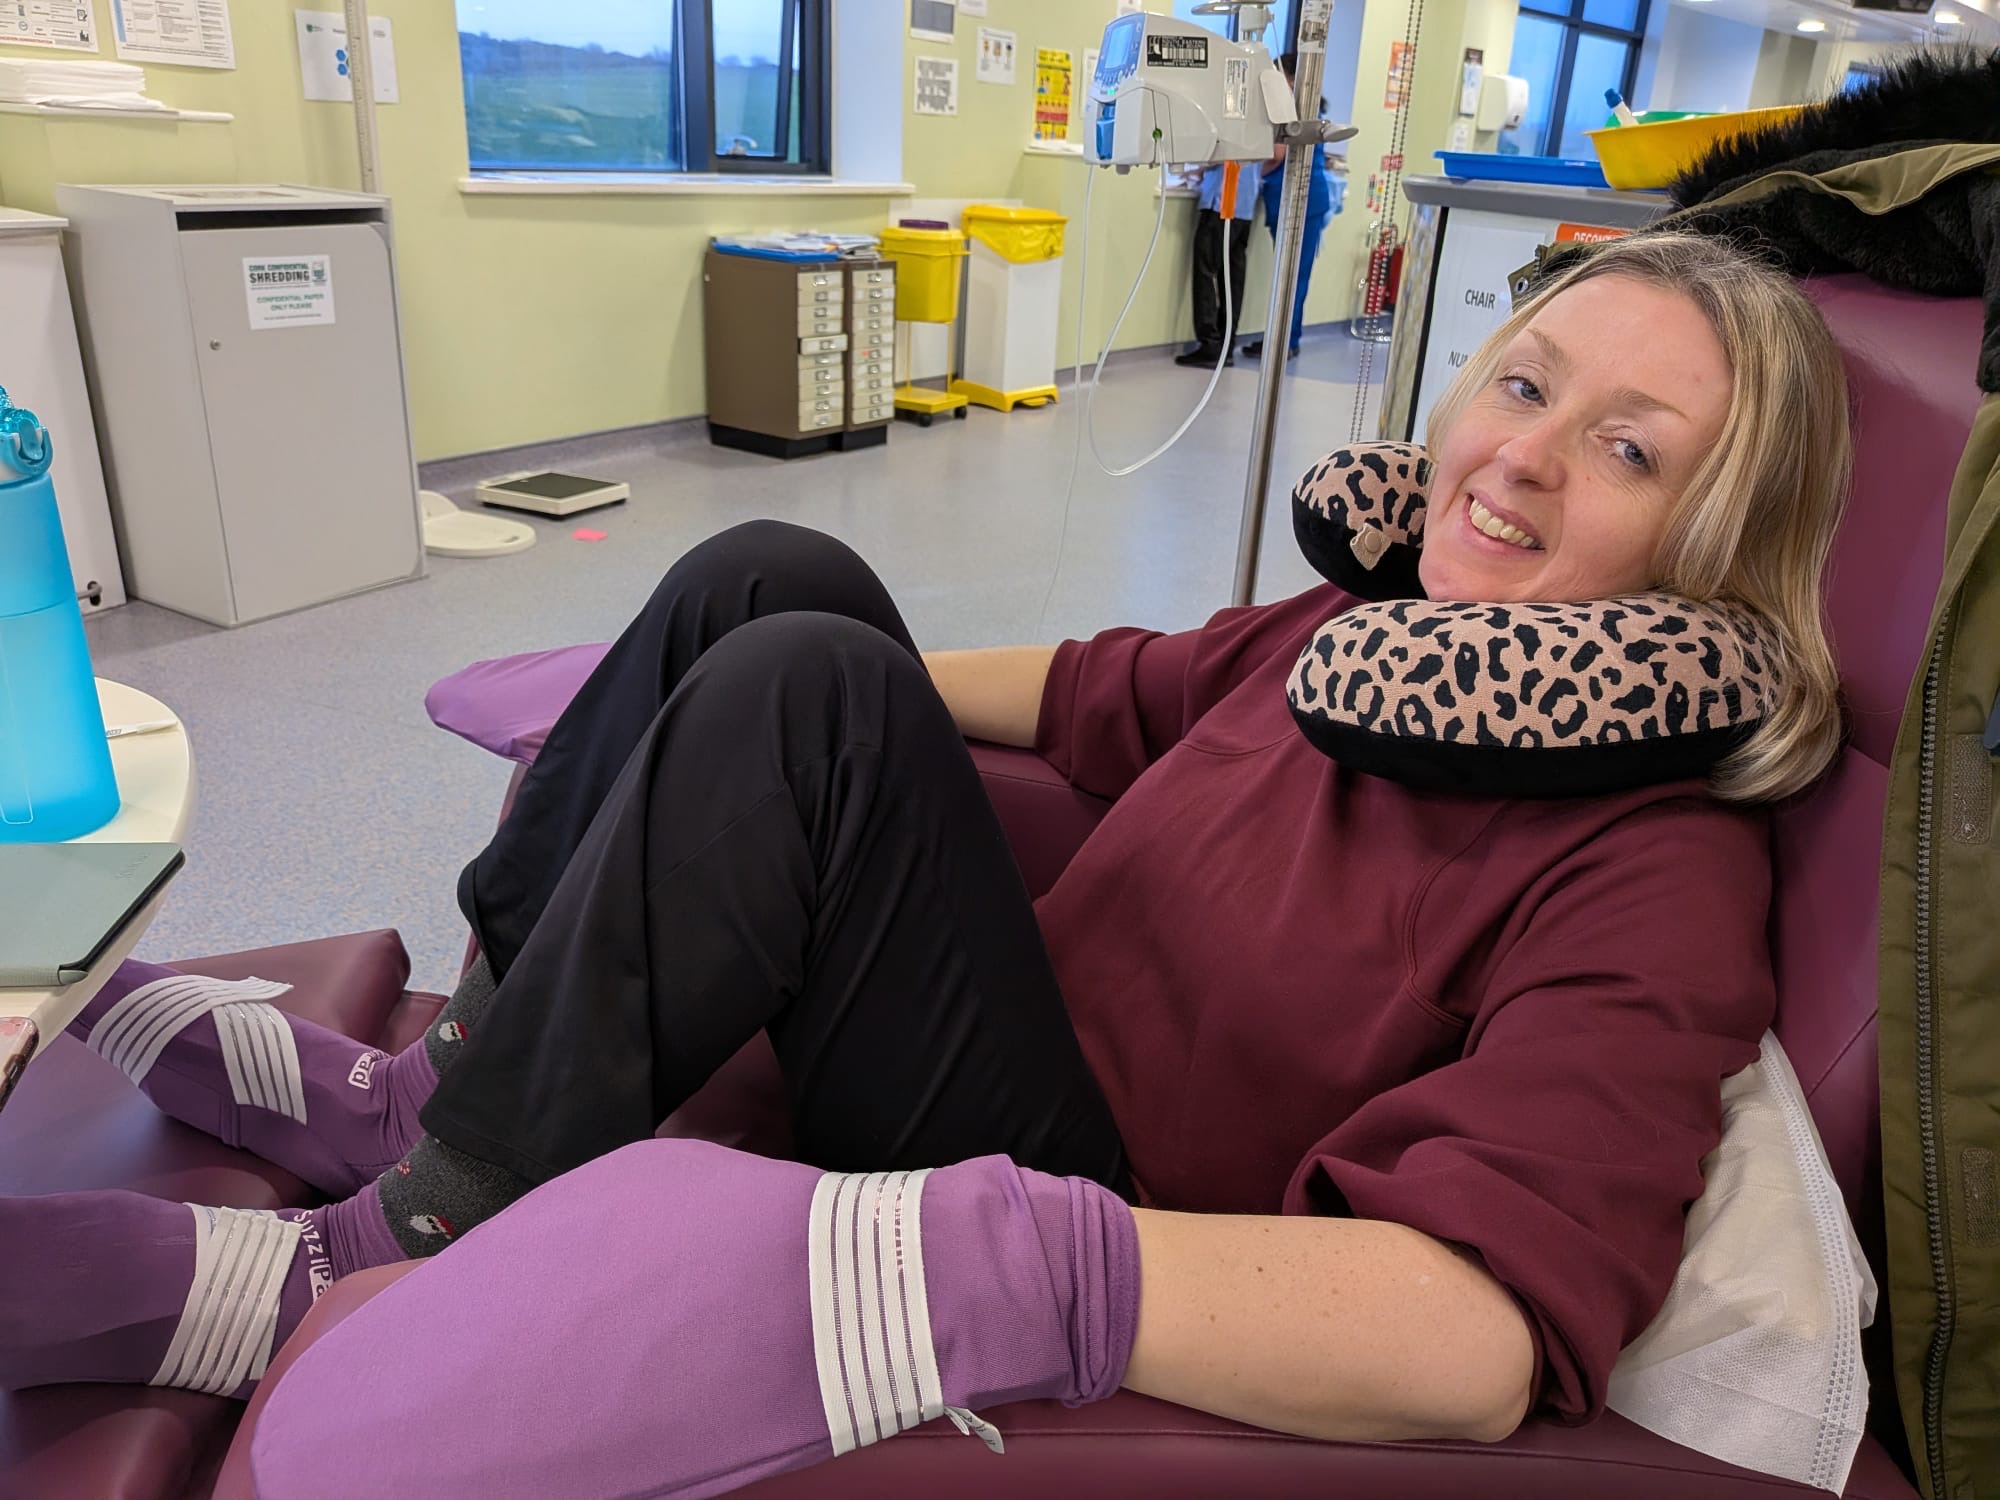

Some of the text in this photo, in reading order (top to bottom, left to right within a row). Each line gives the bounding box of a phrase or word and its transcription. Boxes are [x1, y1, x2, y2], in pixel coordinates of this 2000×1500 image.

[249, 270, 310, 284] SHREDDING
[1464, 288, 1496, 310] CHAIR
[294, 1209, 332, 1298] SuzziPa
